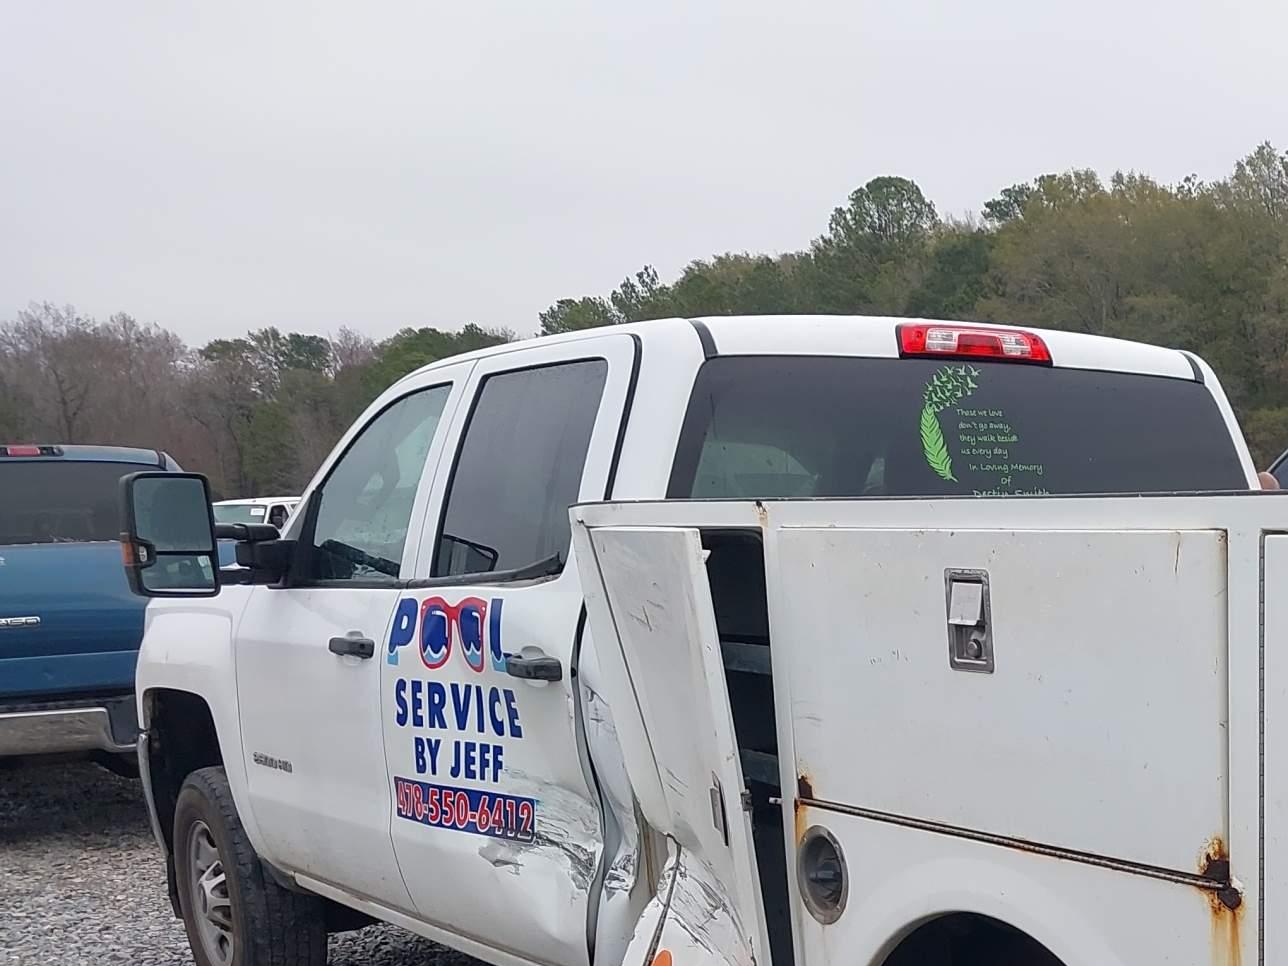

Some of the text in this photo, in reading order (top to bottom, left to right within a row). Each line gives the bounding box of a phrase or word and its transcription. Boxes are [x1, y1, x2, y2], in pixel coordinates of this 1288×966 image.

[989, 409, 1002, 417] love
[979, 423, 988, 431] go
[960, 433, 976, 445] they
[977, 434, 996, 442] walk
[972, 448, 992, 459] every
[994, 447, 1008, 459] day
[969, 463, 1043, 475] In Loving Memory
[387, 596, 517, 673] POOL
[395, 678, 523, 738] SERVICE
[414, 736, 504, 783] BY JEFF
[397, 781, 534, 840] 478-550-6412
